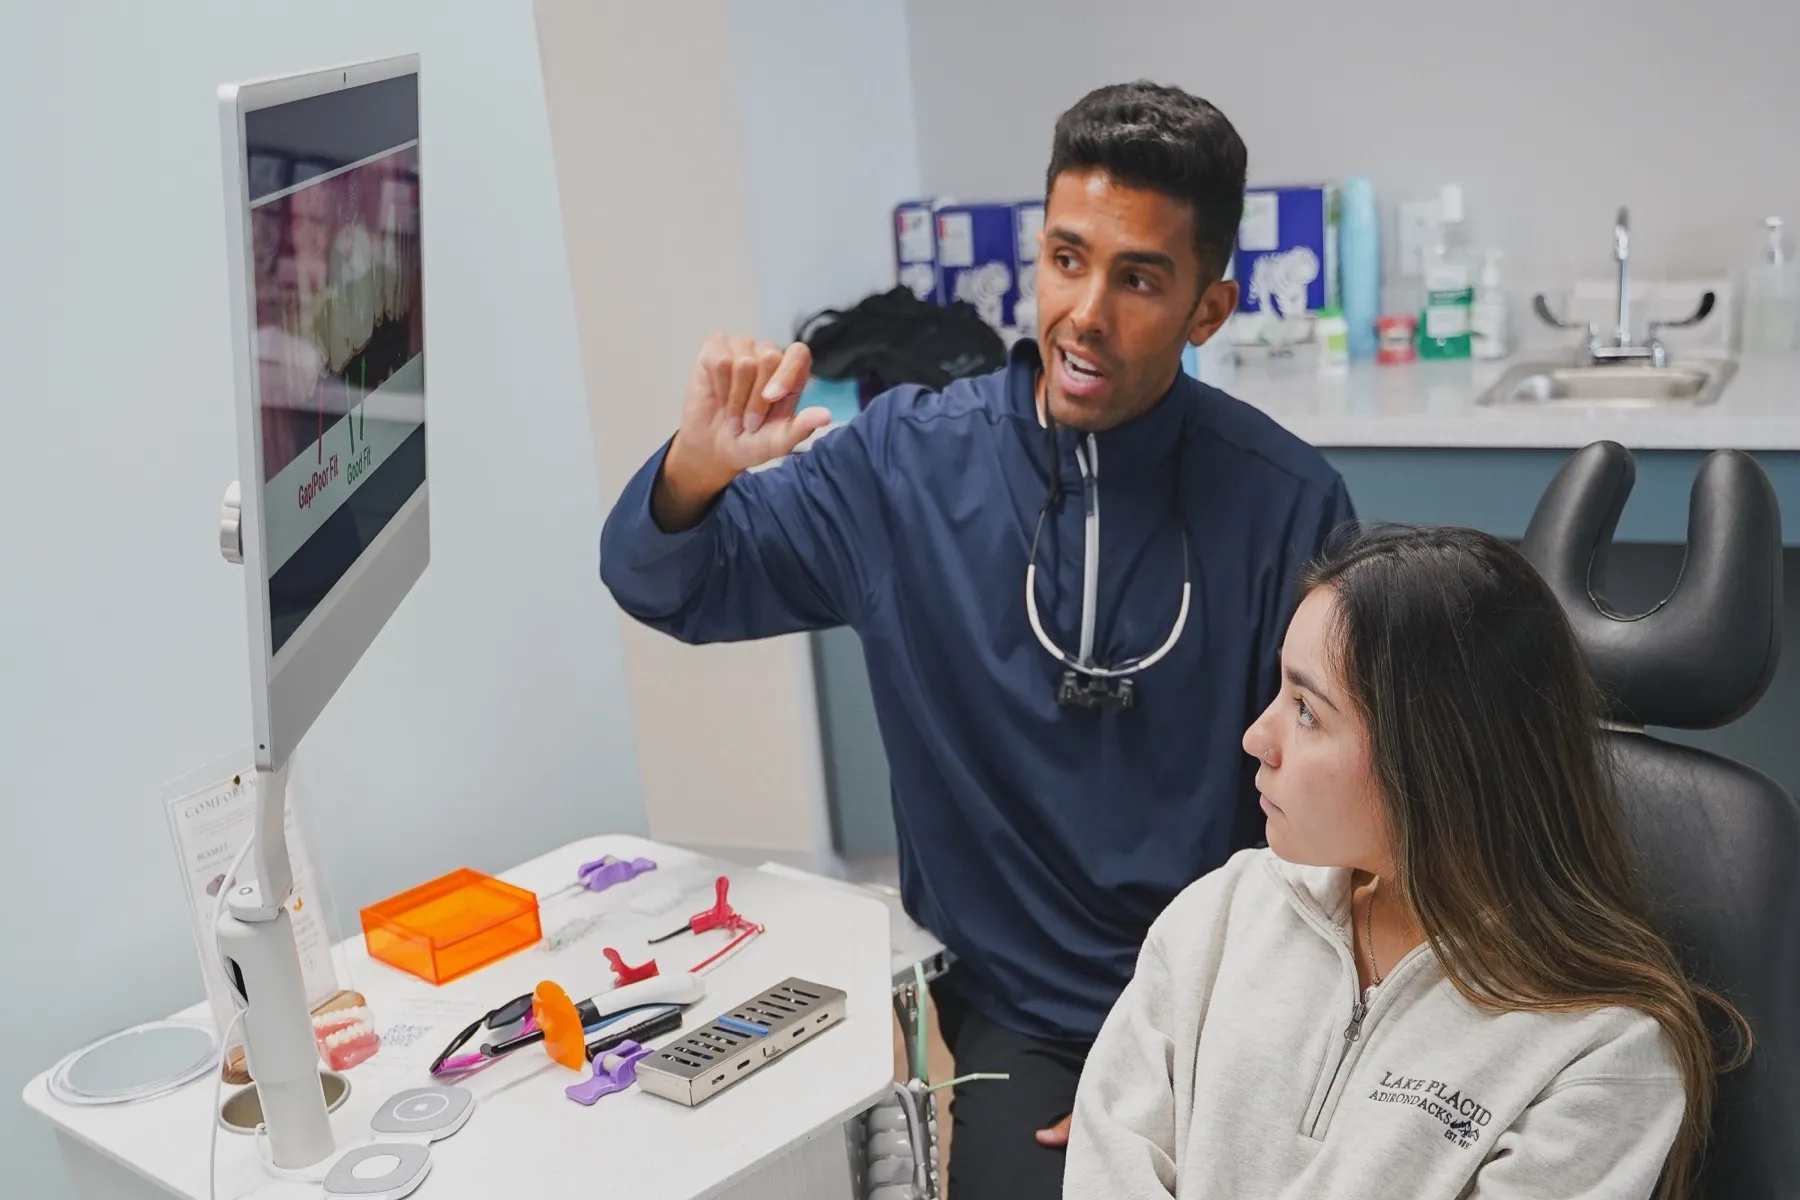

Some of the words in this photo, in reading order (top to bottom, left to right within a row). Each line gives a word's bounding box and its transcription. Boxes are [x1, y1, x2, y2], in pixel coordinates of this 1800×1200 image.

[298, 467, 329, 509] Gap/Poor
[329, 453, 339, 481] Fit
[347, 452, 363, 485] Good
[363, 444, 371, 470] Fit
[184, 784, 246, 819] COMFORT
[1368, 1090, 1453, 1126] ADIRONDACKS
[1380, 1071, 1426, 1091] LAKE
[1425, 1080, 1492, 1127] PLACID
[1444, 1129, 1457, 1143] EST.
